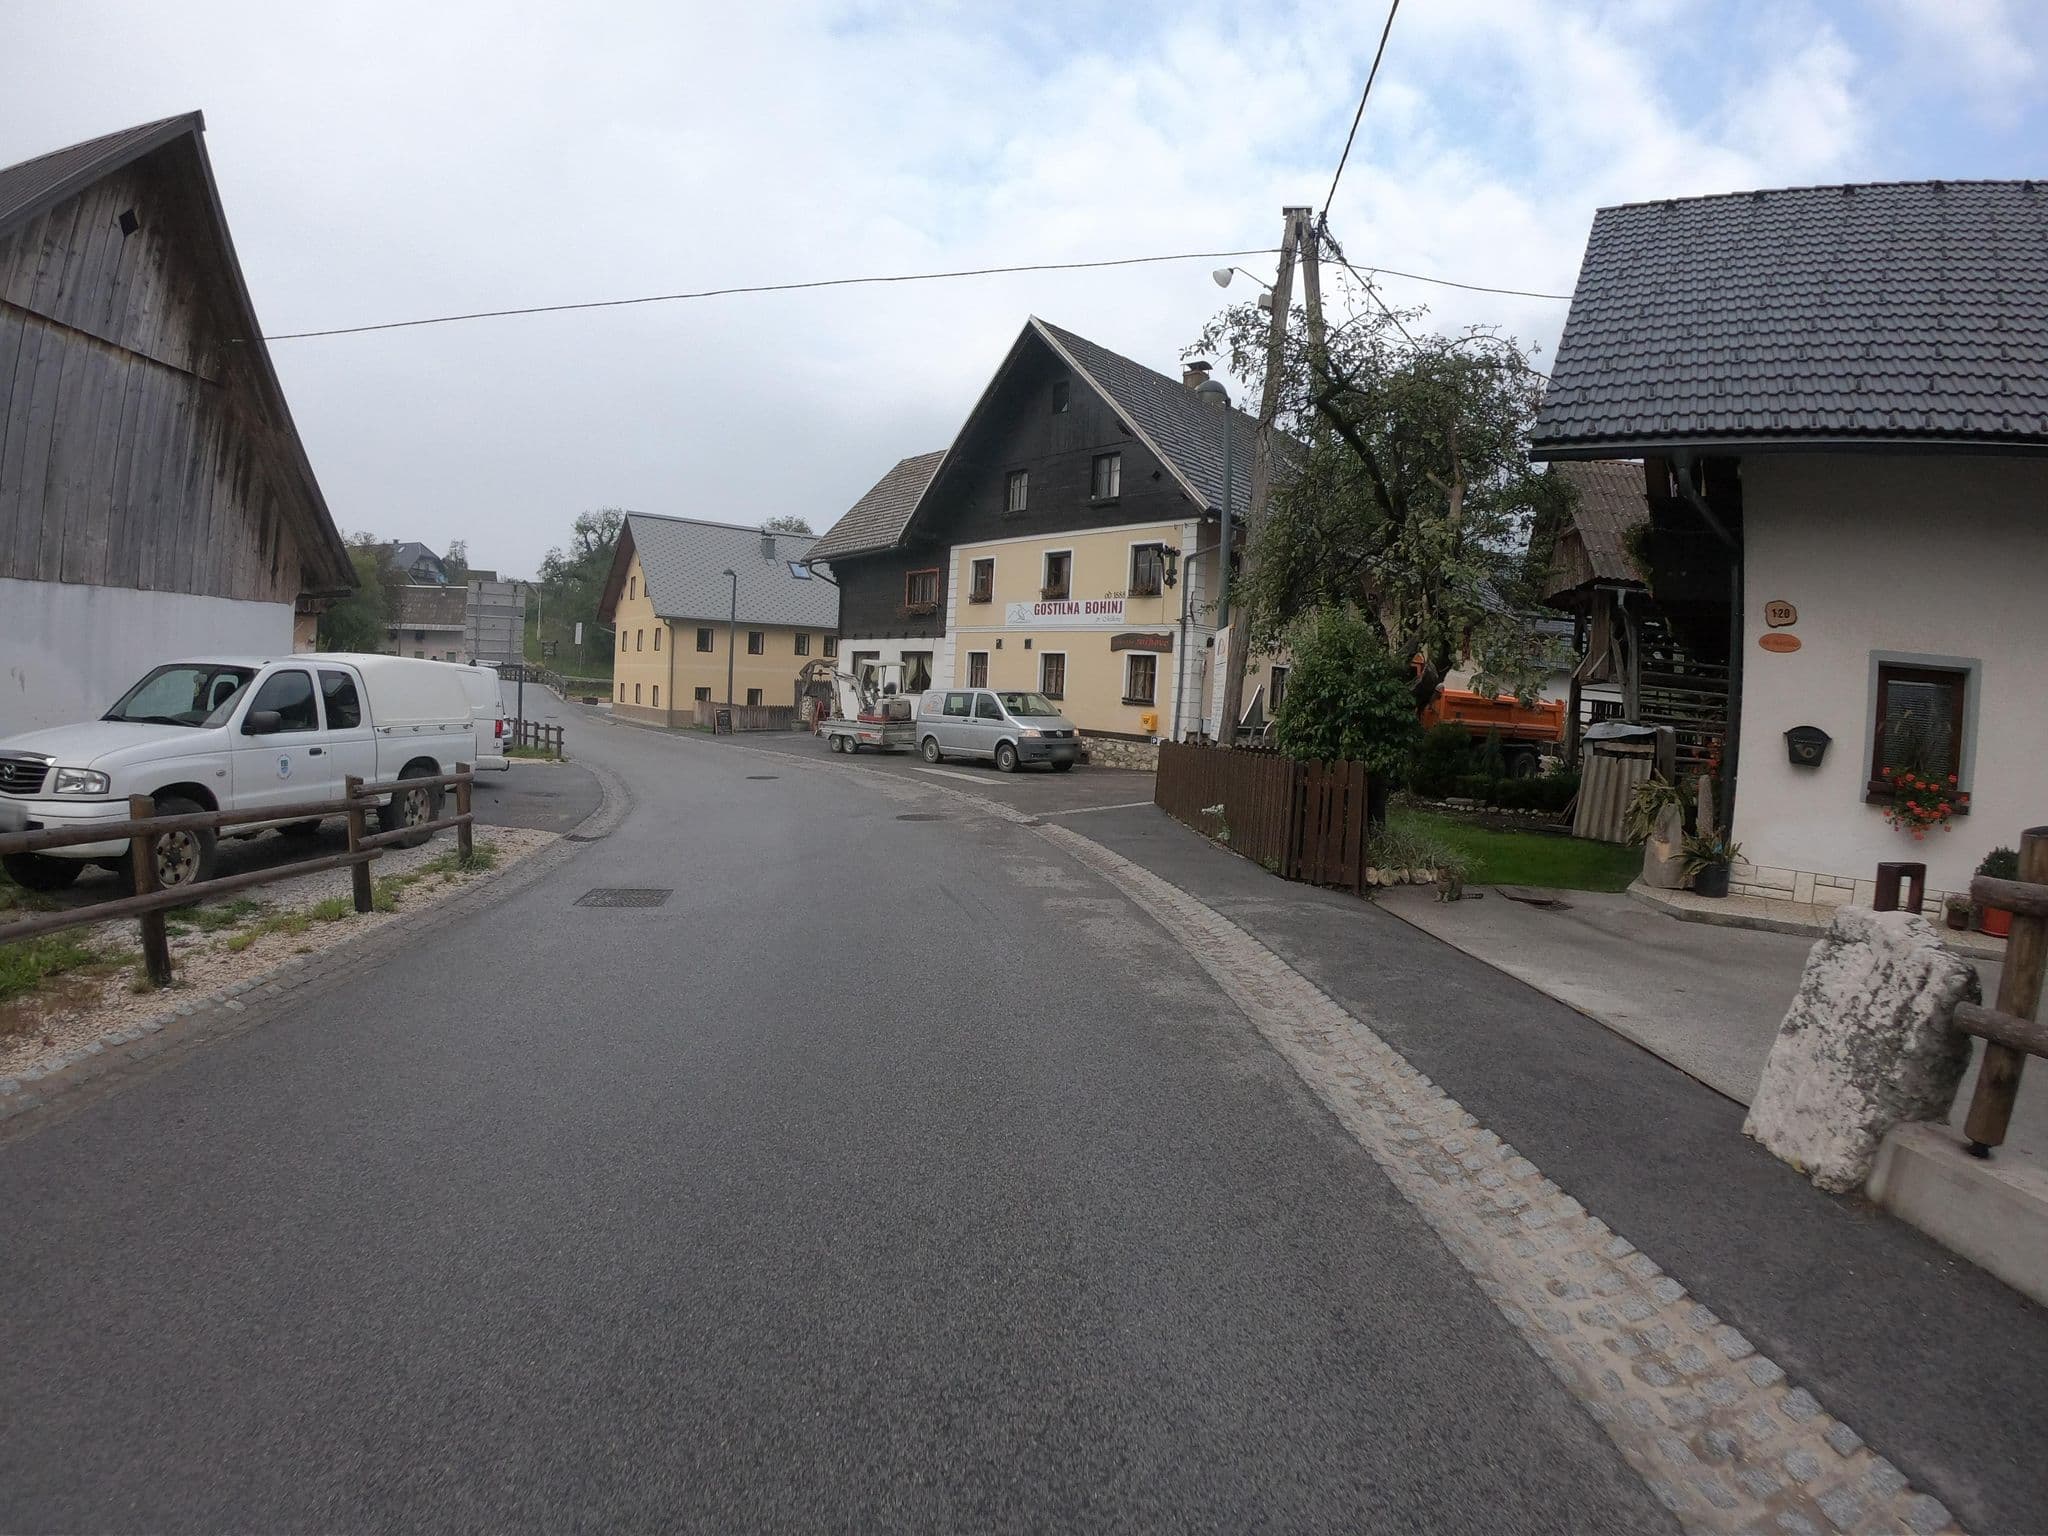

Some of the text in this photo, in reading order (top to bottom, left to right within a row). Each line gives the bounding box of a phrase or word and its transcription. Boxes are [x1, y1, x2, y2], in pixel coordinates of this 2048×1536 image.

[1034, 600, 1122, 616] GOSTILNA BOHINJ
[1772, 608, 1790, 618] 120
